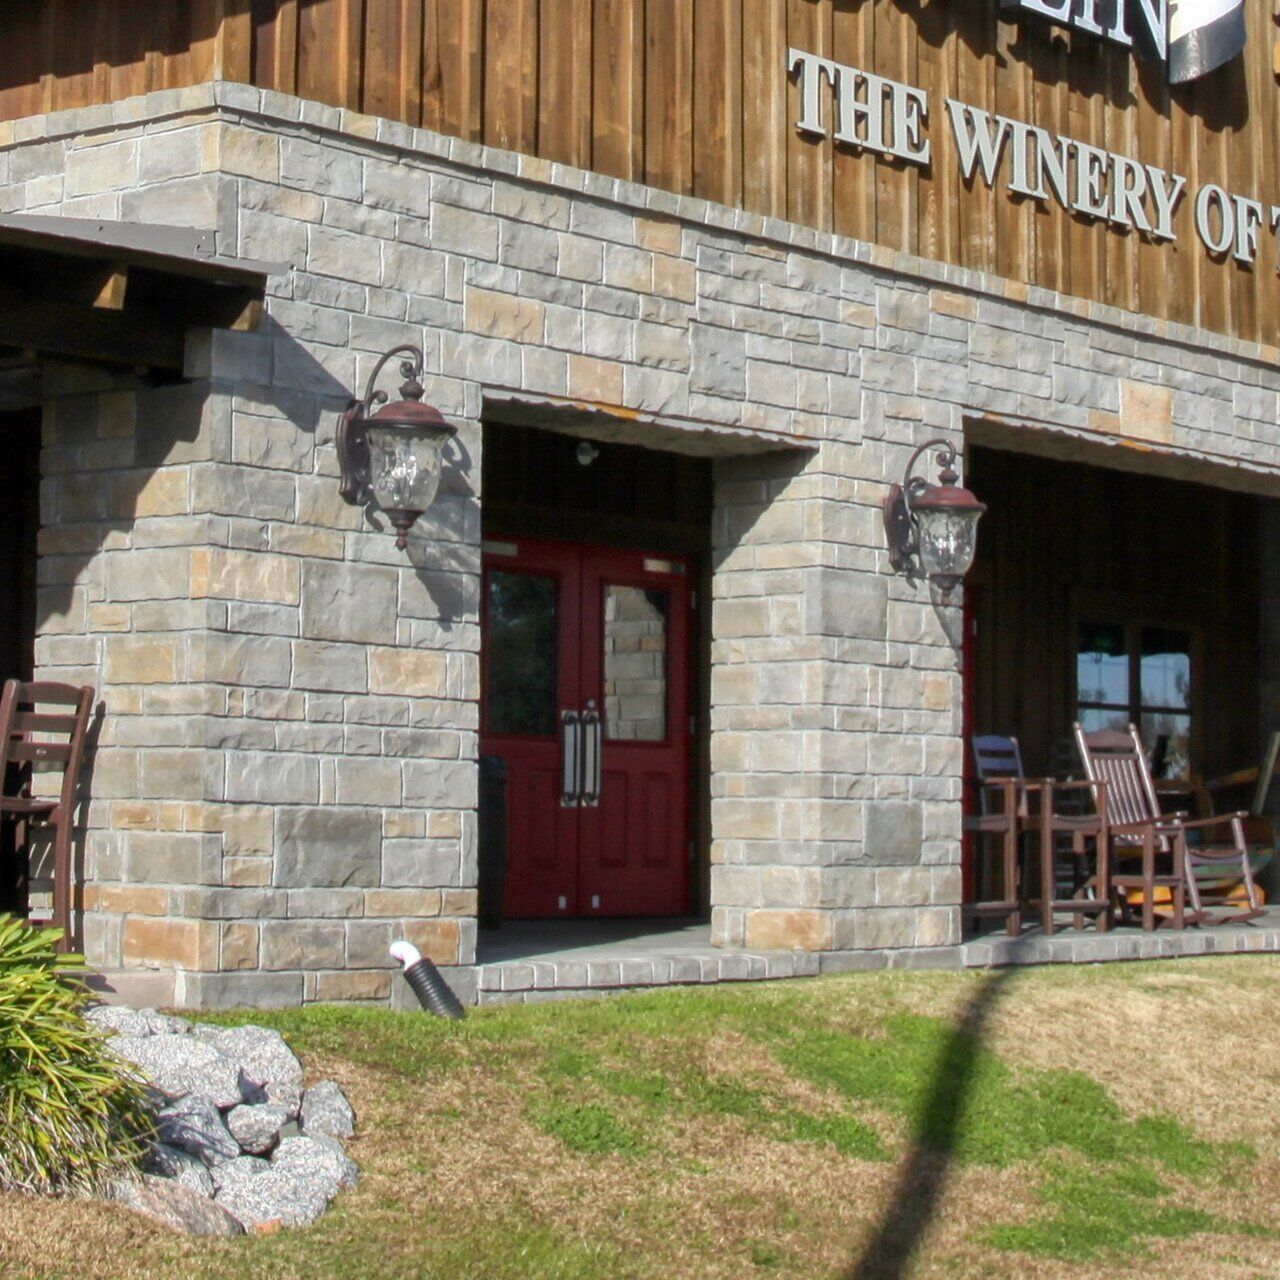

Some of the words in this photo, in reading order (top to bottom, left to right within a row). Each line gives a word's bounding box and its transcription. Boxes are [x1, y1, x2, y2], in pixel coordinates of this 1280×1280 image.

[787, 47, 931, 165] THE
[945, 97, 1186, 241] WINERY
[1195, 183, 1262, 263] OF
